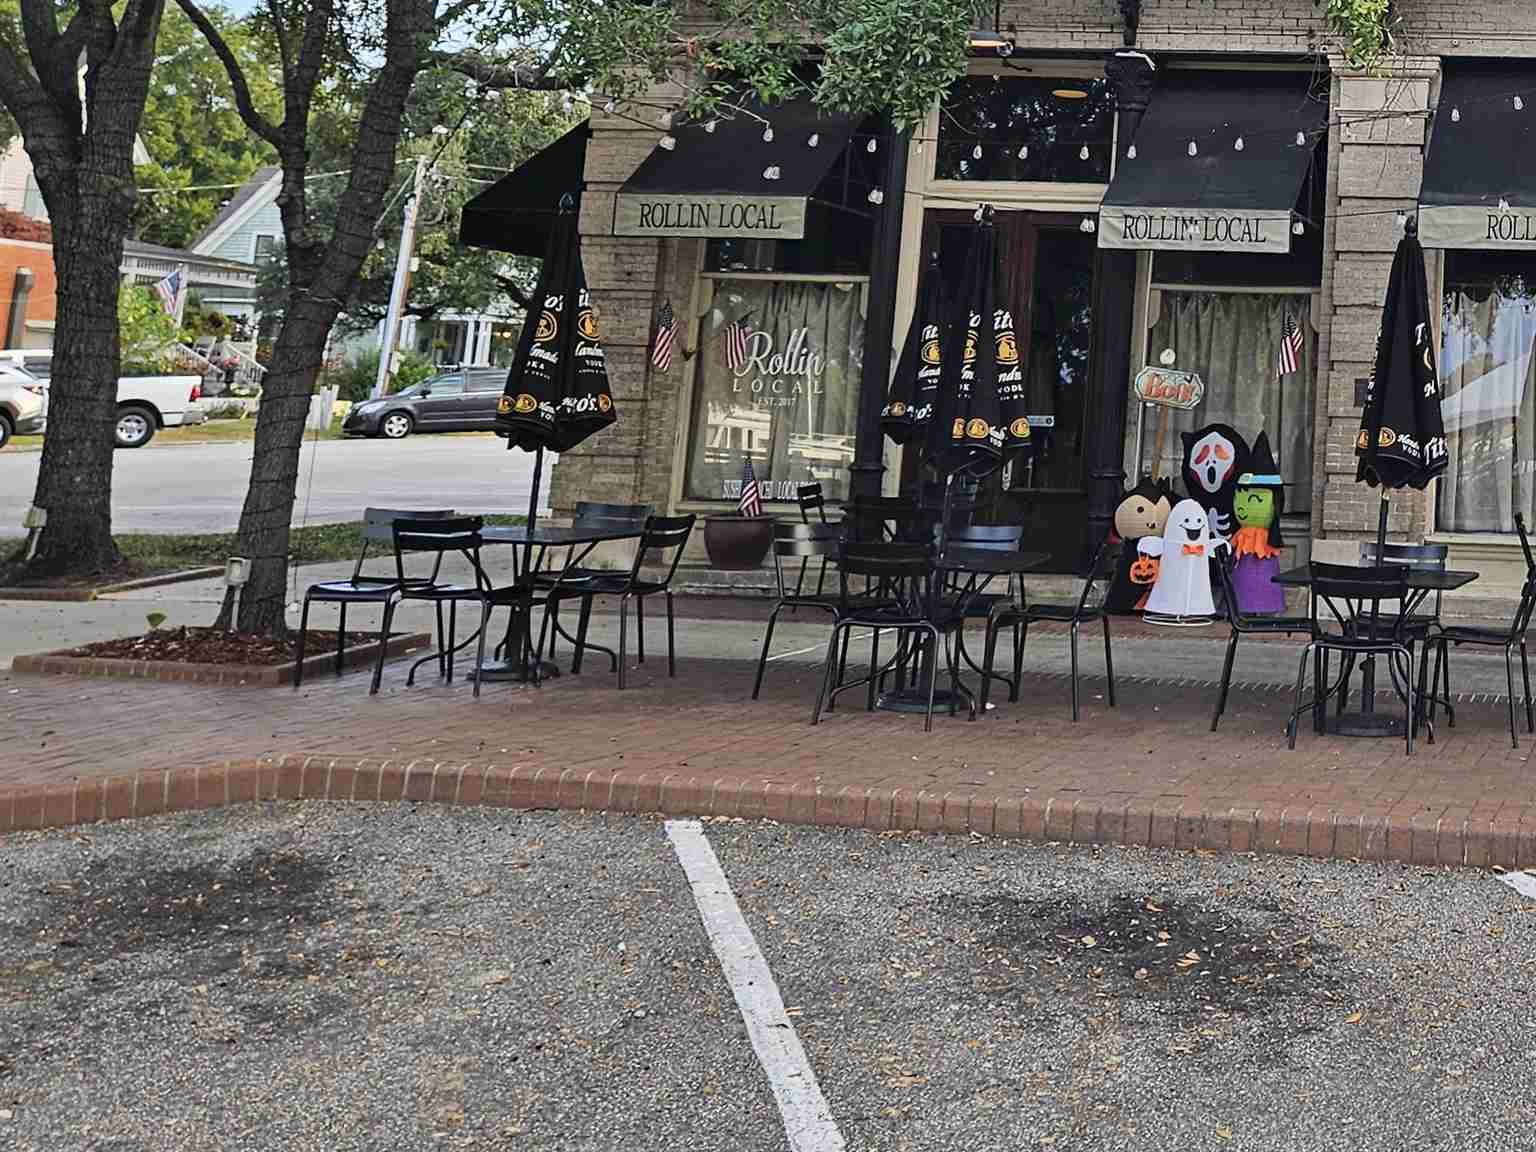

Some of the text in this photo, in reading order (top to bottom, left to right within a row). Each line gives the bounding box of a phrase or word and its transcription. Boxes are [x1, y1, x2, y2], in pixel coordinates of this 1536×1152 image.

[638, 202, 782, 230] ROLLIN LOCAL
[1122, 214, 1266, 242] ROLLIN LOCAL
[733, 327, 826, 377] Rollin
[732, 378, 824, 394] LOCAL
